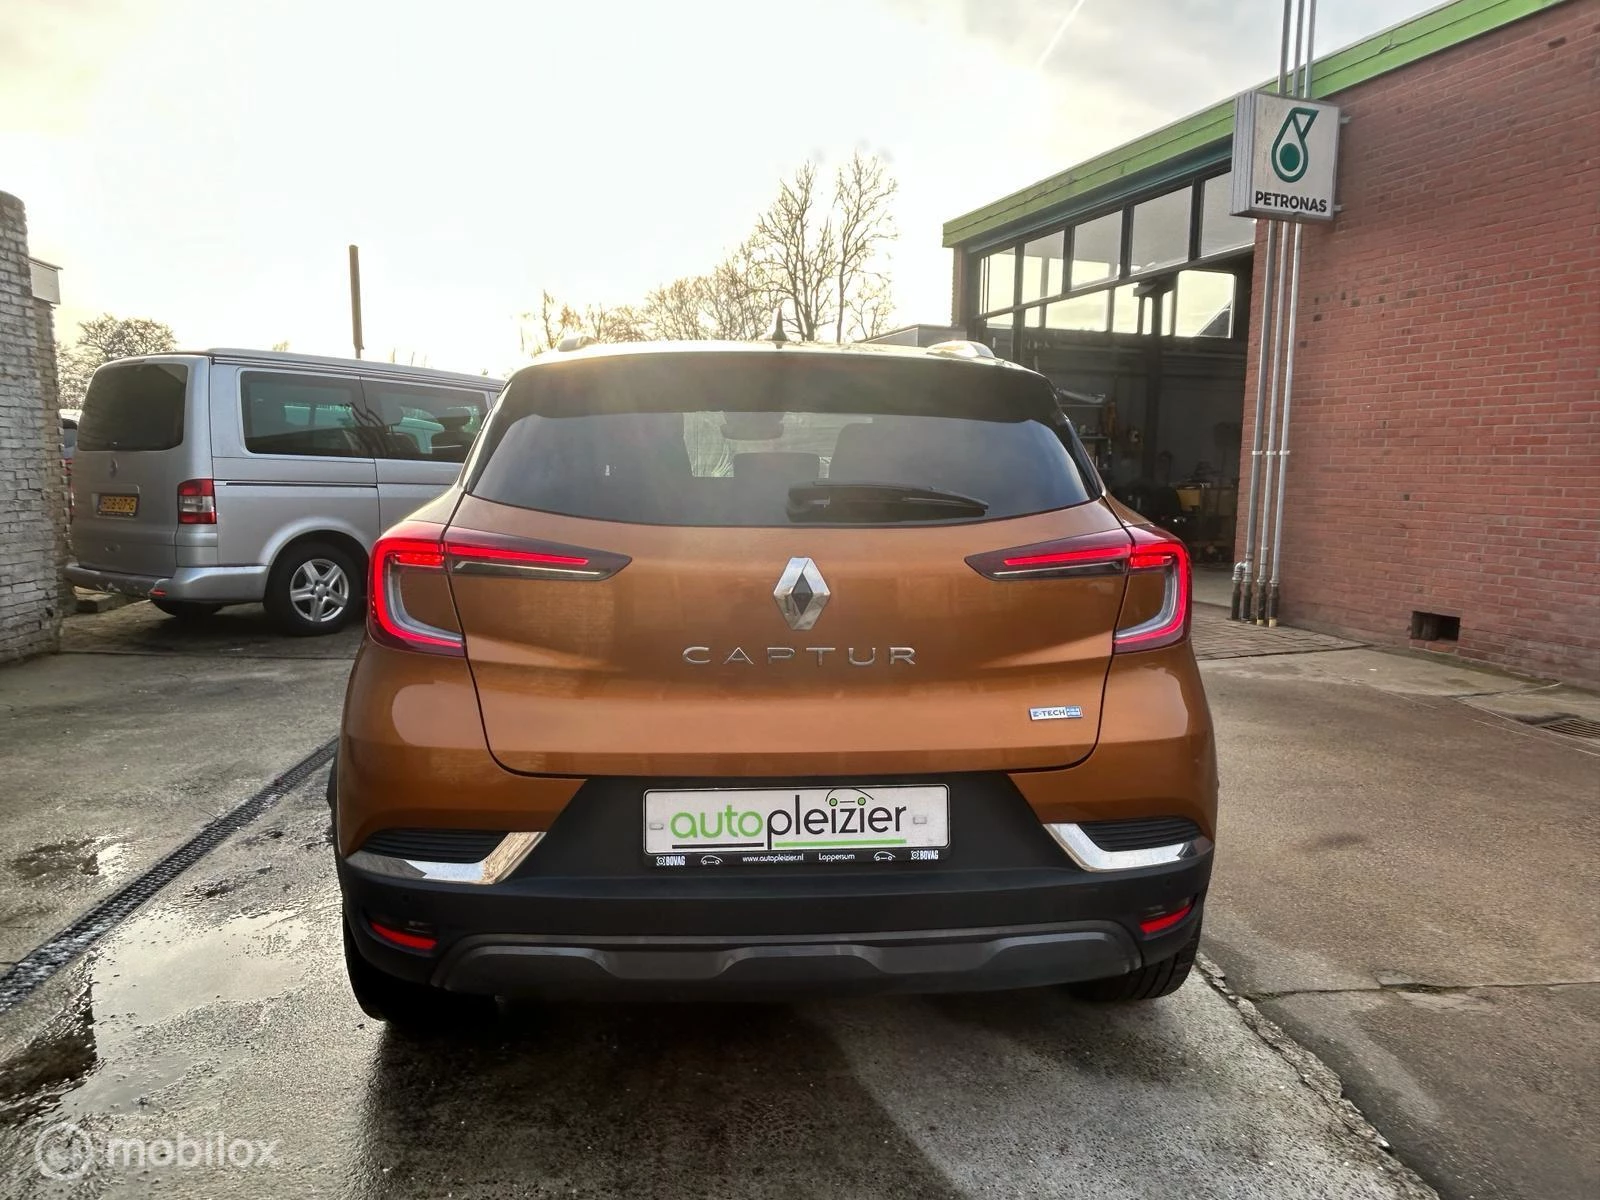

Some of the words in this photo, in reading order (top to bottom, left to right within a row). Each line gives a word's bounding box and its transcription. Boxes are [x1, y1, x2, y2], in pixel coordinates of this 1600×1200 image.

[1254, 190, 1328, 212] PETRONAS
[682, 646, 917, 666] CAPTUR
[670, 794, 907, 850] autopleizier
[666, 855, 686, 866] BOVAG
[742, 853, 804, 864] www.autopleizier.nl
[818, 852, 855, 863] Loppersum
[919, 850, 939, 860] BOVAG
